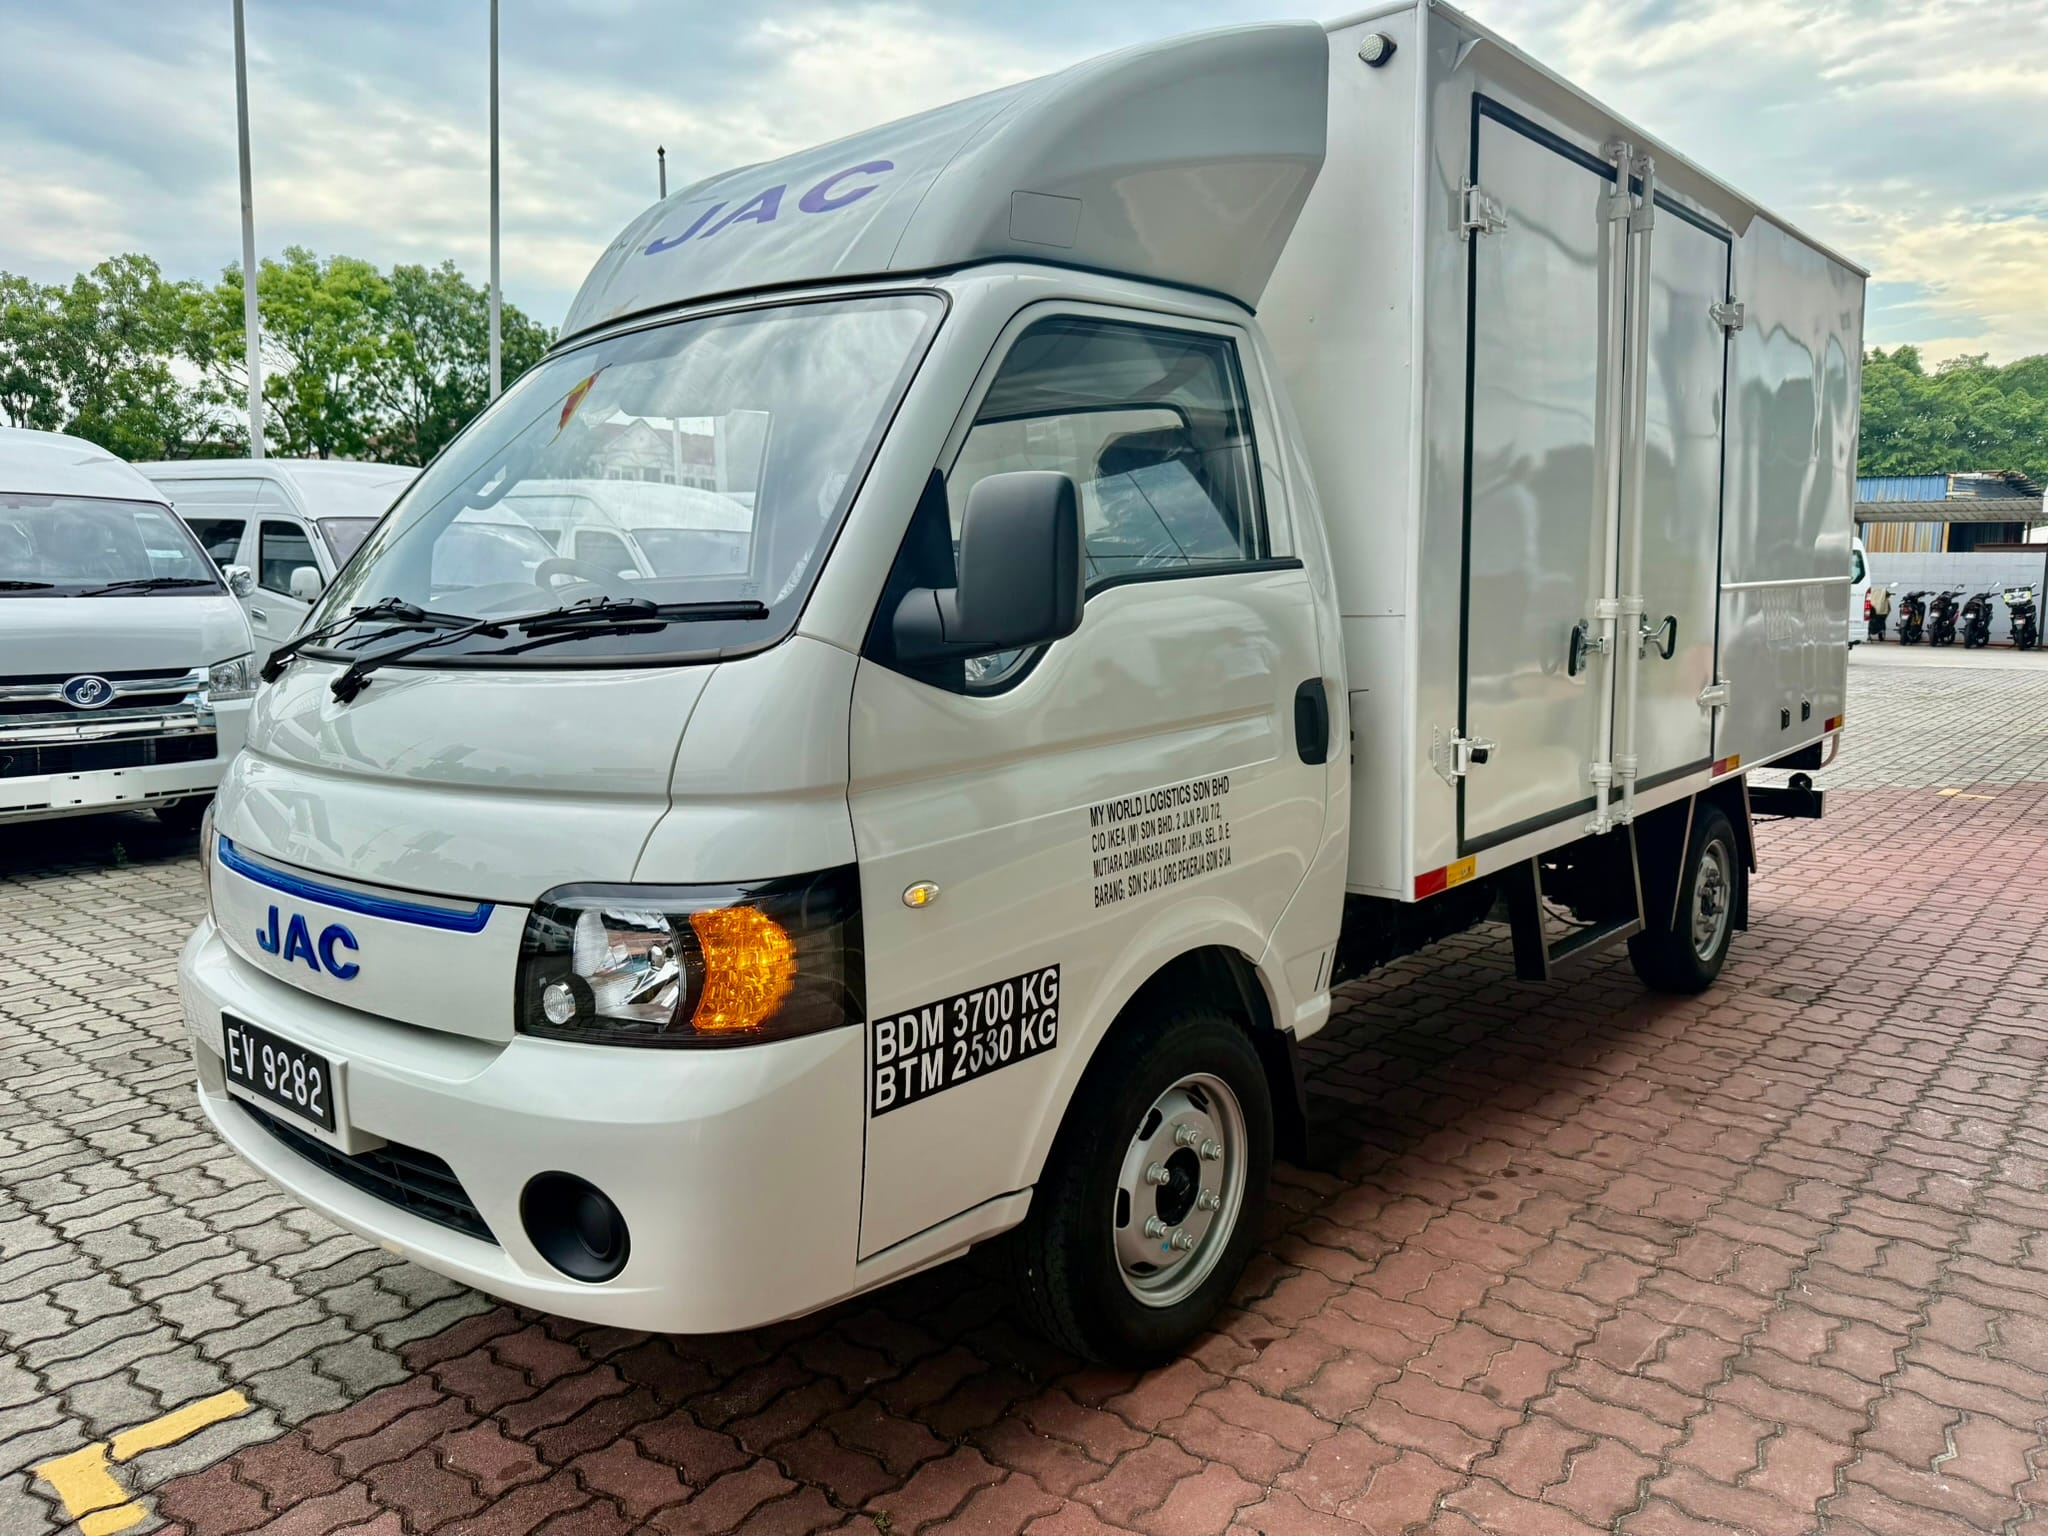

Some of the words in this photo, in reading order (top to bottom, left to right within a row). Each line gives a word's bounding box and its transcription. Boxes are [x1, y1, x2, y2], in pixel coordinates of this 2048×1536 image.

[644, 160, 894, 256] JAC
[1090, 804, 1104, 827] MY
[1107, 796, 1142, 823] WORLD
[1144, 784, 1191, 814] LOGISTICS
[1193, 780, 1210, 801] SDN
[1212, 775, 1230, 797] BHD
[1108, 827, 1126, 848] IKEA
[1128, 823, 1139, 848] (M)
[1141, 820, 1156, 840] SDN
[1176, 812, 1181, 830] 2
[1182, 808, 1195, 828] JLN
[1196, 805, 1209, 824] PJU
[1093, 849, 1123, 878] MUTIARA
[1125, 841, 1163, 869] DAMANSARA
[1128, 872, 1142, 897] SDN
[1158, 866, 1163, 888] 3
[1164, 861, 1177, 886] ORG
[1178, 853, 1205, 881] PEKERJA
[1206, 849, 1218, 872] SDN
[256, 905, 360, 981] JAC
[876, 1004, 944, 1065] BDM
[953, 982, 1014, 1038] 3700
[1021, 968, 1058, 1014] KG
[228, 1028, 254, 1081] EV
[262, 1045, 324, 1118] 9282
[875, 1047, 944, 1110] BTM
[951, 1023, 1013, 1081] 2530
[1020, 1007, 1056, 1054] KG
